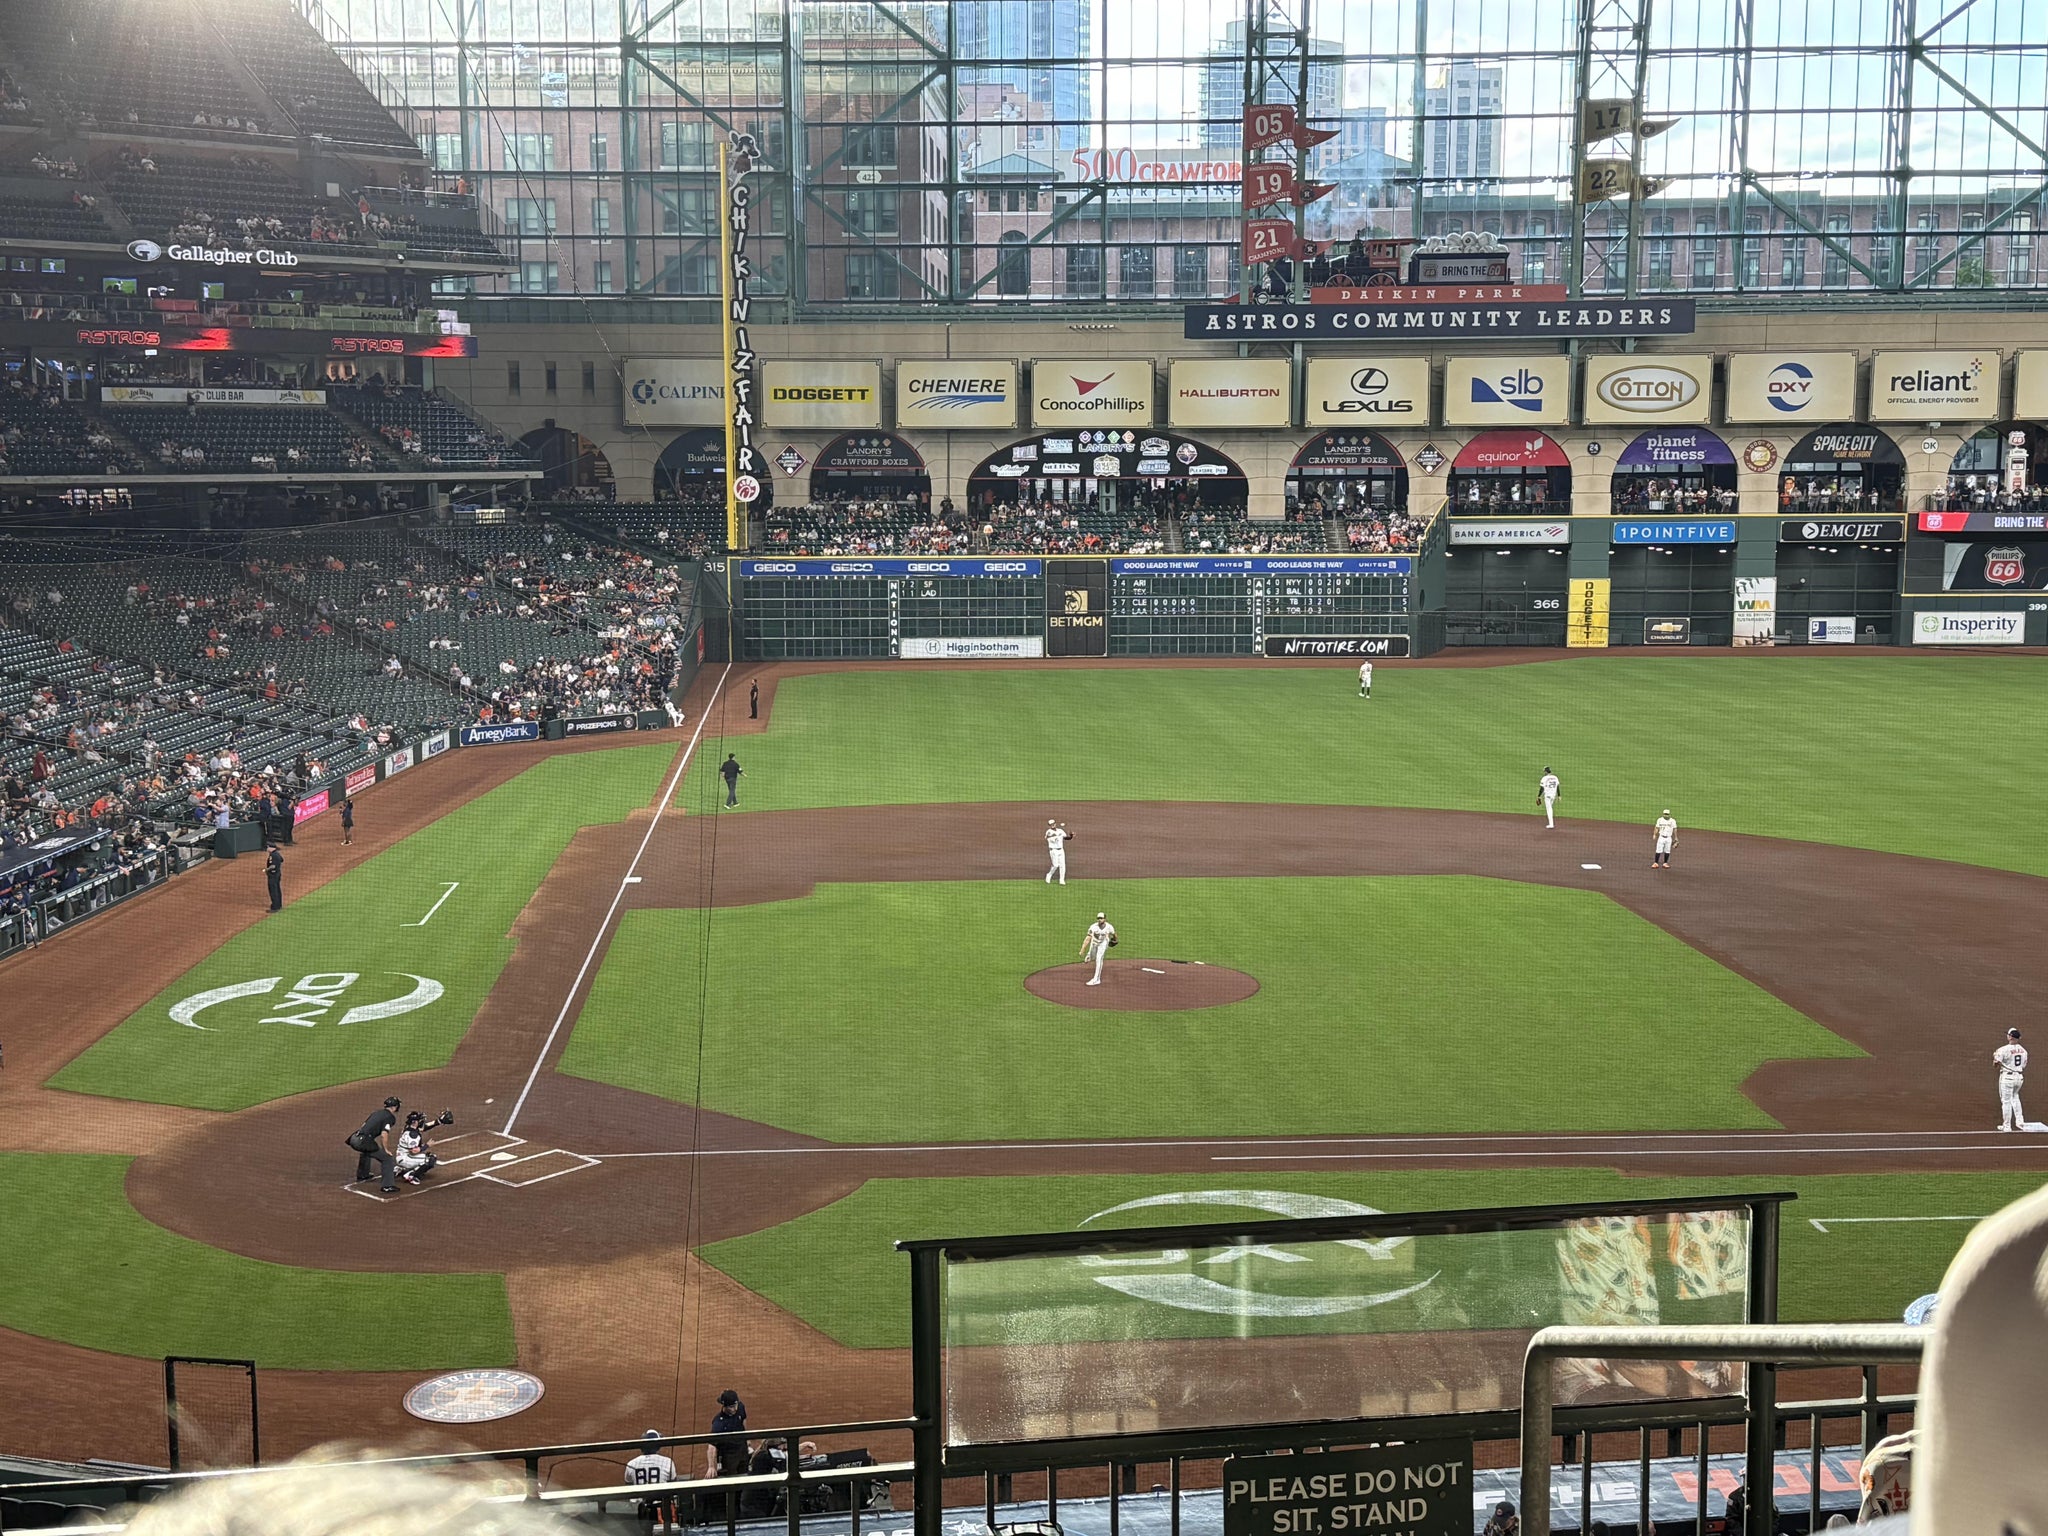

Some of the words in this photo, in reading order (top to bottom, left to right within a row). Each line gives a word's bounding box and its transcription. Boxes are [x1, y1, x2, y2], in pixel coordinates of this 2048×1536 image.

[1256, 113, 1282, 136] 05
[1594, 107, 1621, 130] 17
[1252, 132, 1292, 148] CHAMPIONS
[1072, 148, 1138, 182] 500
[1138, 162, 1242, 182] CRAWFOR
[1257, 174, 1282, 194] 19
[1590, 170, 1617, 190] 22
[1252, 191, 1290, 206] CHAMPIONS
[1254, 228, 1278, 250] 21
[168, 244, 252, 266] Gallagher
[256, 250, 298, 266] Club
[732, 186, 749, 320] CHIKIN
[1248, 247, 1285, 260] CHAMPIONS
[1442, 266, 1468, 276] BRING
[1470, 266, 1487, 276] THE
[1342, 290, 1436, 299] DAIKIN
[1458, 288, 1522, 298] PARK
[1206, 313, 1316, 330] ASTROS
[1332, 311, 1521, 328] COMMUNITY
[1538, 308, 1672, 326] LEADERS
[78, 330, 160, 345] ASTROS
[332, 338, 404, 352] ASTROS
[909, 379, 1006, 392] CHENIERE
[1500, 368, 1544, 394] slb
[1768, 382, 1810, 392] OXY
[1891, 370, 1972, 392] reliant
[206, 392, 226, 400] CLUB
[228, 392, 244, 400] BAR
[774, 388, 868, 400] DOGGETT
[1180, 388, 1280, 398] HALLIBURTON
[1610, 377, 1683, 401] COTTON
[1040, 398, 1144, 412] ConocoPhillips
[1323, 400, 1413, 413] LEXUS
[735, 380, 752, 471] FAIR
[1079, 444, 1135, 452] LANDRY'S
[1647, 434, 1696, 450] planet
[1813, 436, 1850, 452] SPACE
[1850, 436, 1878, 450] CITY
[688, 454, 725, 462] Budweis
[1478, 451, 1521, 463] equinor
[1653, 448, 1706, 460] fitness
[1994, 516, 2026, 527] BRING
[2026, 516, 2044, 527] THE
[1620, 527, 1728, 538] 1POINTFIVE
[1818, 524, 1882, 538] EMCJET
[704, 562, 726, 572] 315
[754, 564, 796, 572] GEICO
[831, 563, 873, 572] GEICO
[908, 563, 949, 572] GEICO
[984, 563, 1026, 571] GEICO
[1992, 563, 2016, 576] 66
[1534, 600, 1559, 608] 366
[1584, 582, 1594, 639] DOGGETT
[1738, 600, 1772, 610] WM
[1050, 616, 1102, 627] BETMGM
[1942, 616, 2017, 634] Insperity
[947, 642, 1019, 652] Higginbotham
[1285, 639, 1388, 654] NITTOTIRE.COM
[576, 720, 617, 730] PRIZEPICKS
[468, 726, 528, 742] AmegyBank
[432, 1372, 532, 1388] HOUSTON
[421, 1404, 514, 1420] ASTROS
[1230, 1474, 1347, 1504] PLEASE
[1355, 1470, 1396, 1495] DO
[1404, 1462, 1463, 1490] NOT
[1273, 1507, 1323, 1535] SIT,
[1331, 1498, 1428, 1530] STAND
